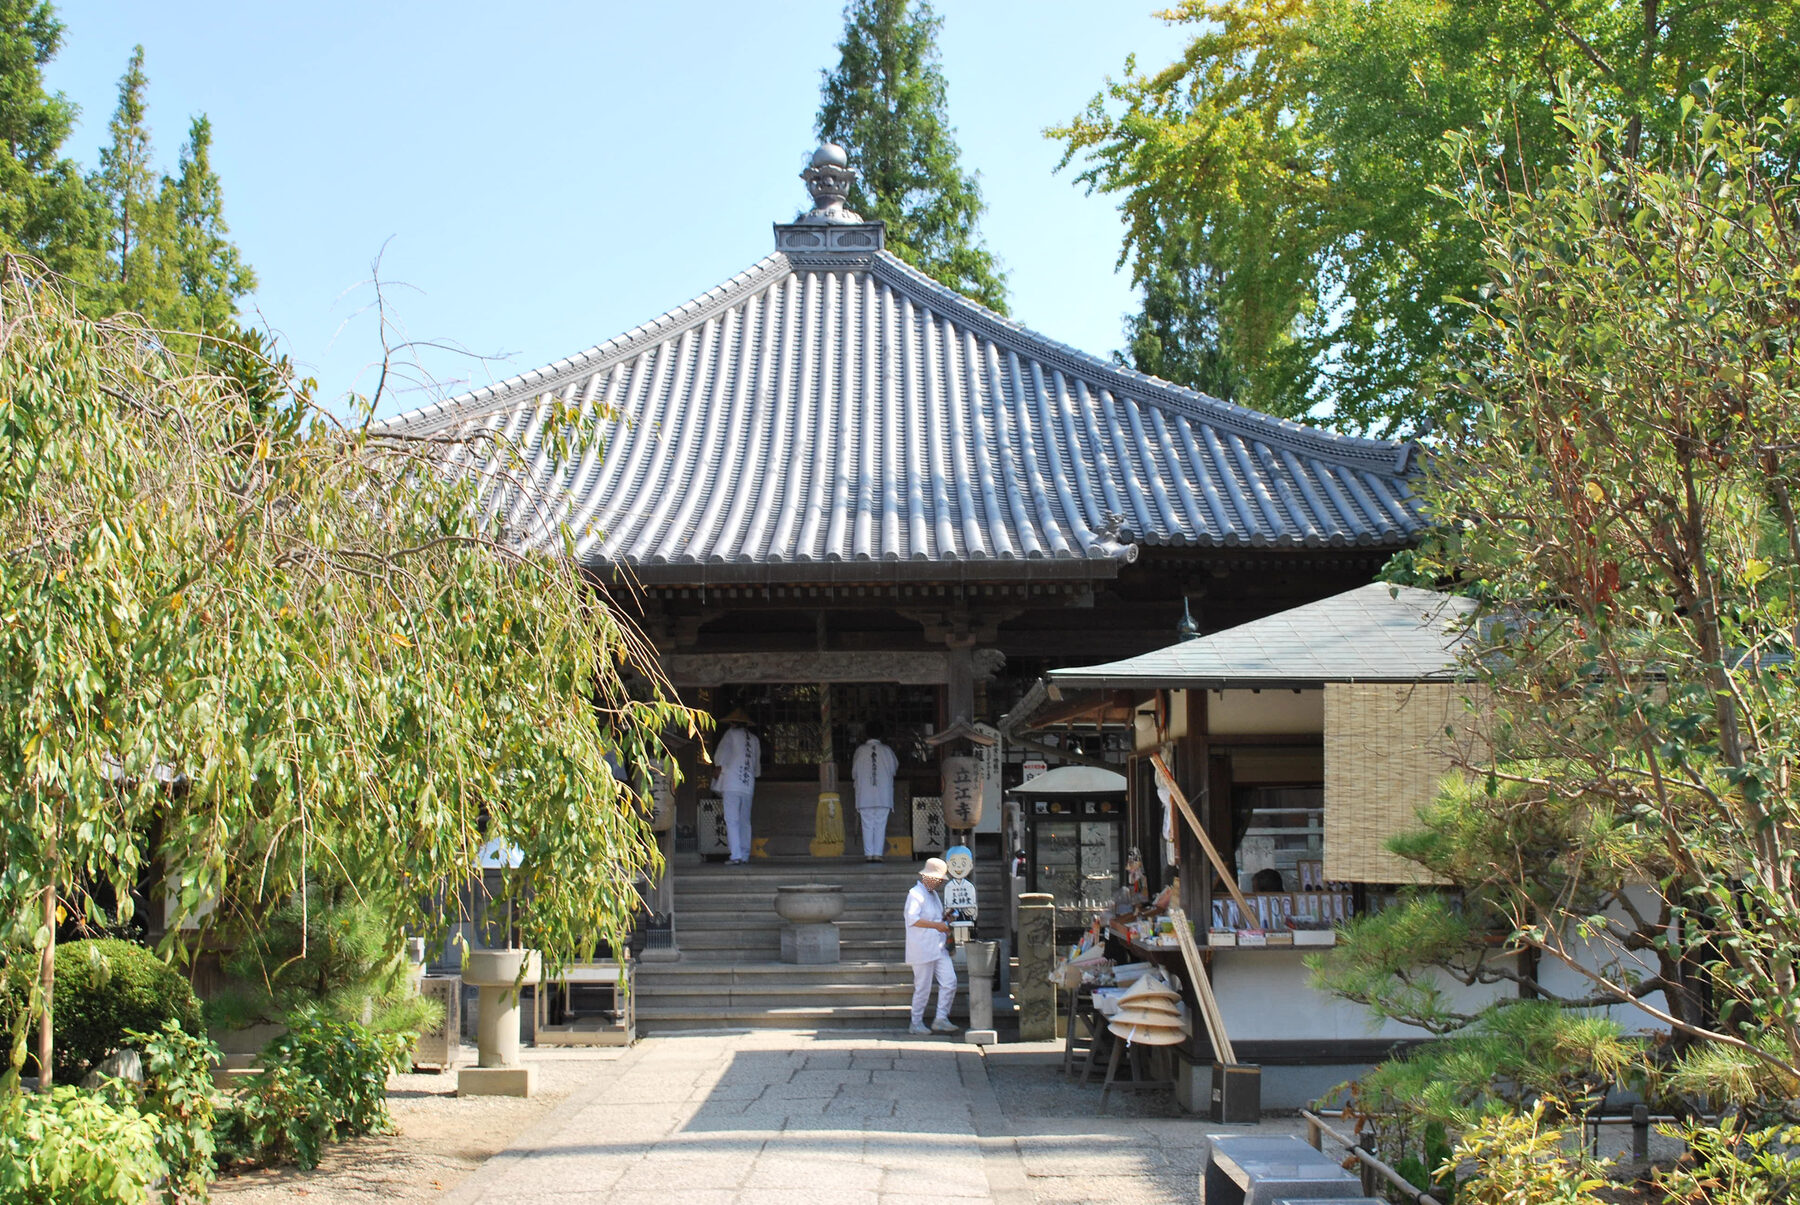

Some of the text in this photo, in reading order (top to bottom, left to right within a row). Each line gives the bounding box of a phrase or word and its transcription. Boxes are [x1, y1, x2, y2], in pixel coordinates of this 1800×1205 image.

[953, 767, 971, 822] 立江寺
[927, 813, 940, 846] 納札入
